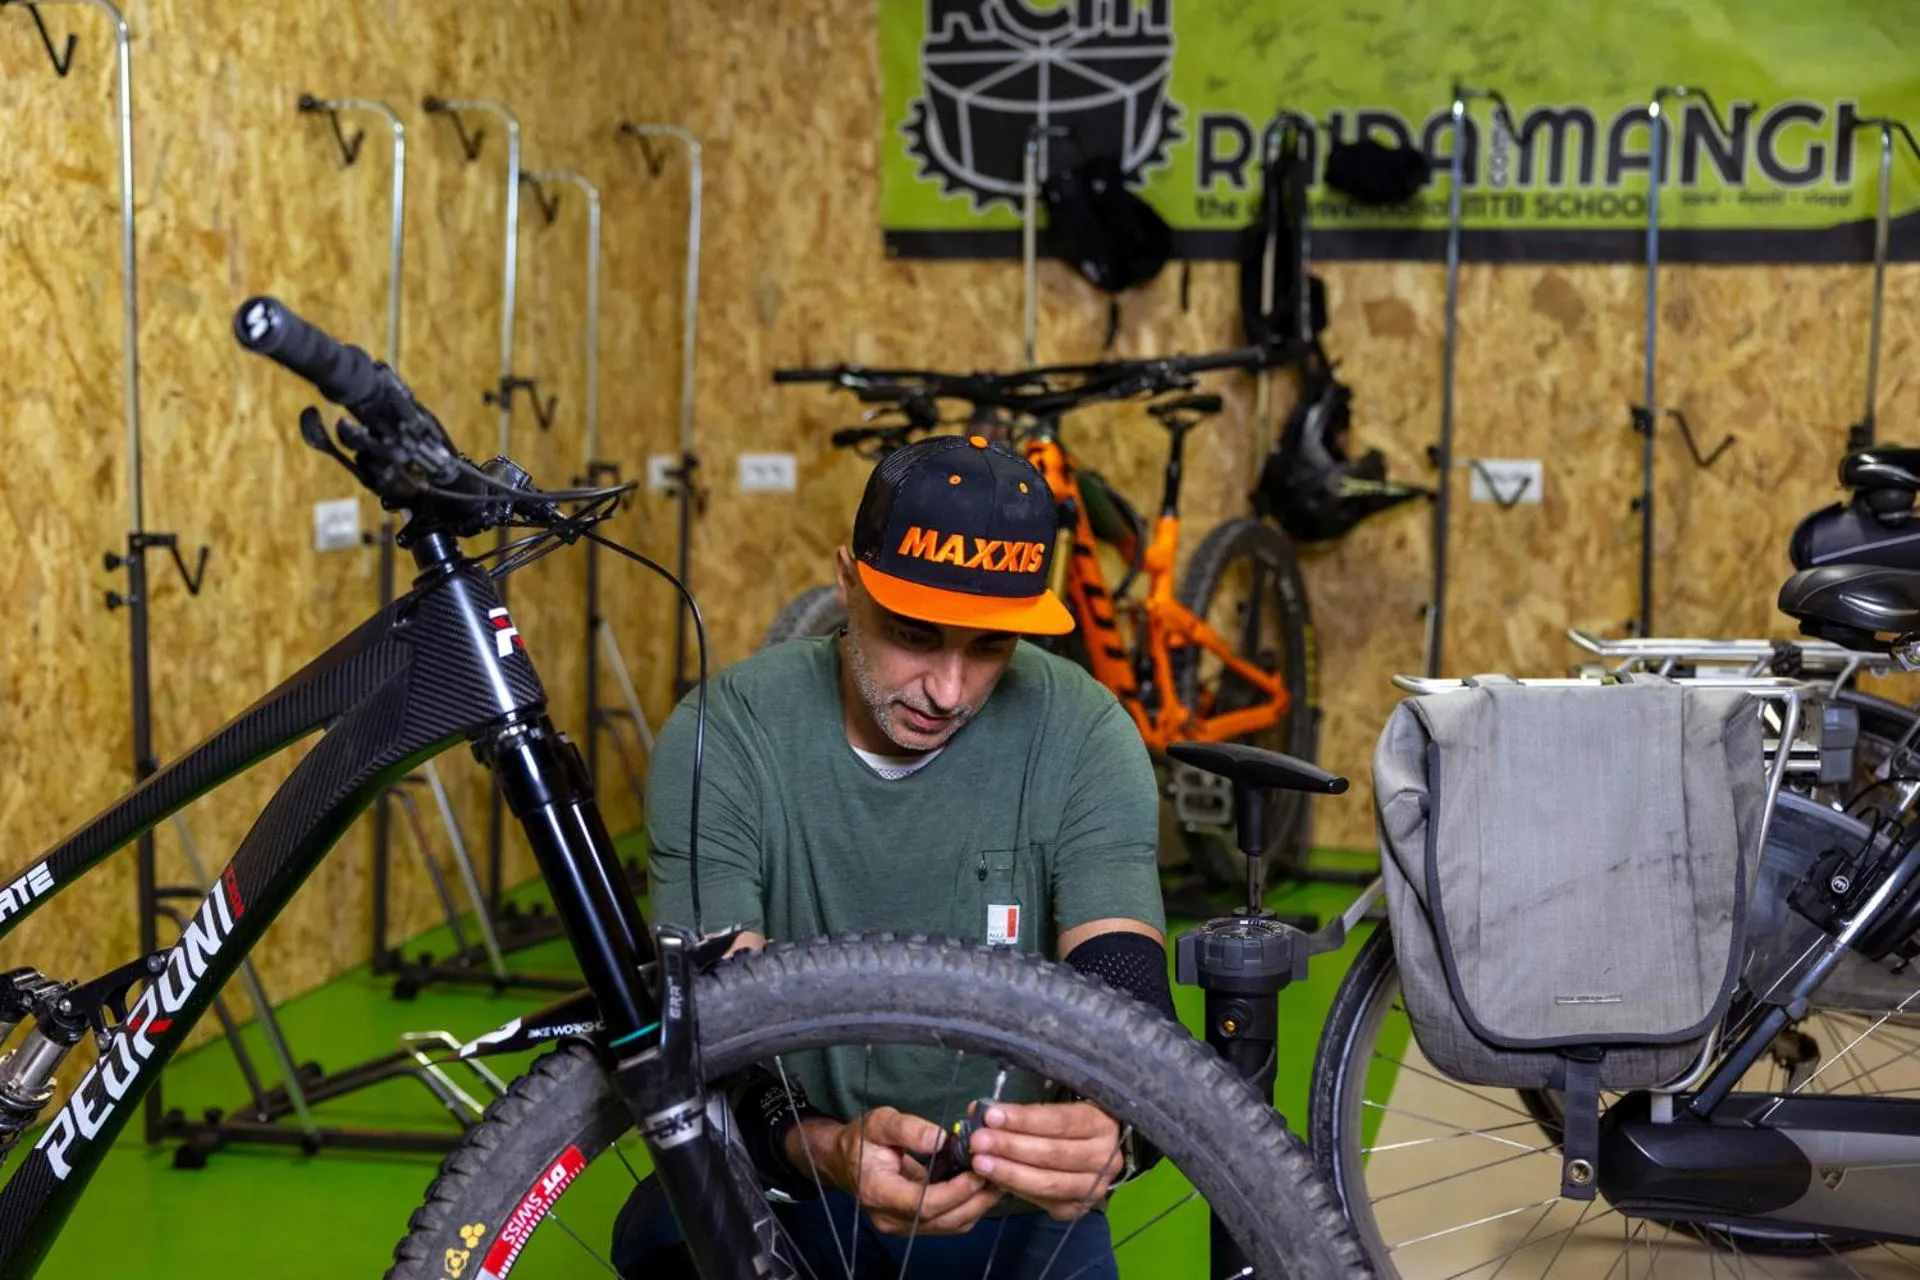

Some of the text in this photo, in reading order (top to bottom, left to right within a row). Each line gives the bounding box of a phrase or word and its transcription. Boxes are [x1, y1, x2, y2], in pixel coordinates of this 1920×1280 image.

[1519, 103, 1855, 188] MANGI
[1536, 193, 1663, 219] SCHOO
[898, 525, 1046, 573] MAXXIS
[501, 1191, 543, 1246] SWISS
